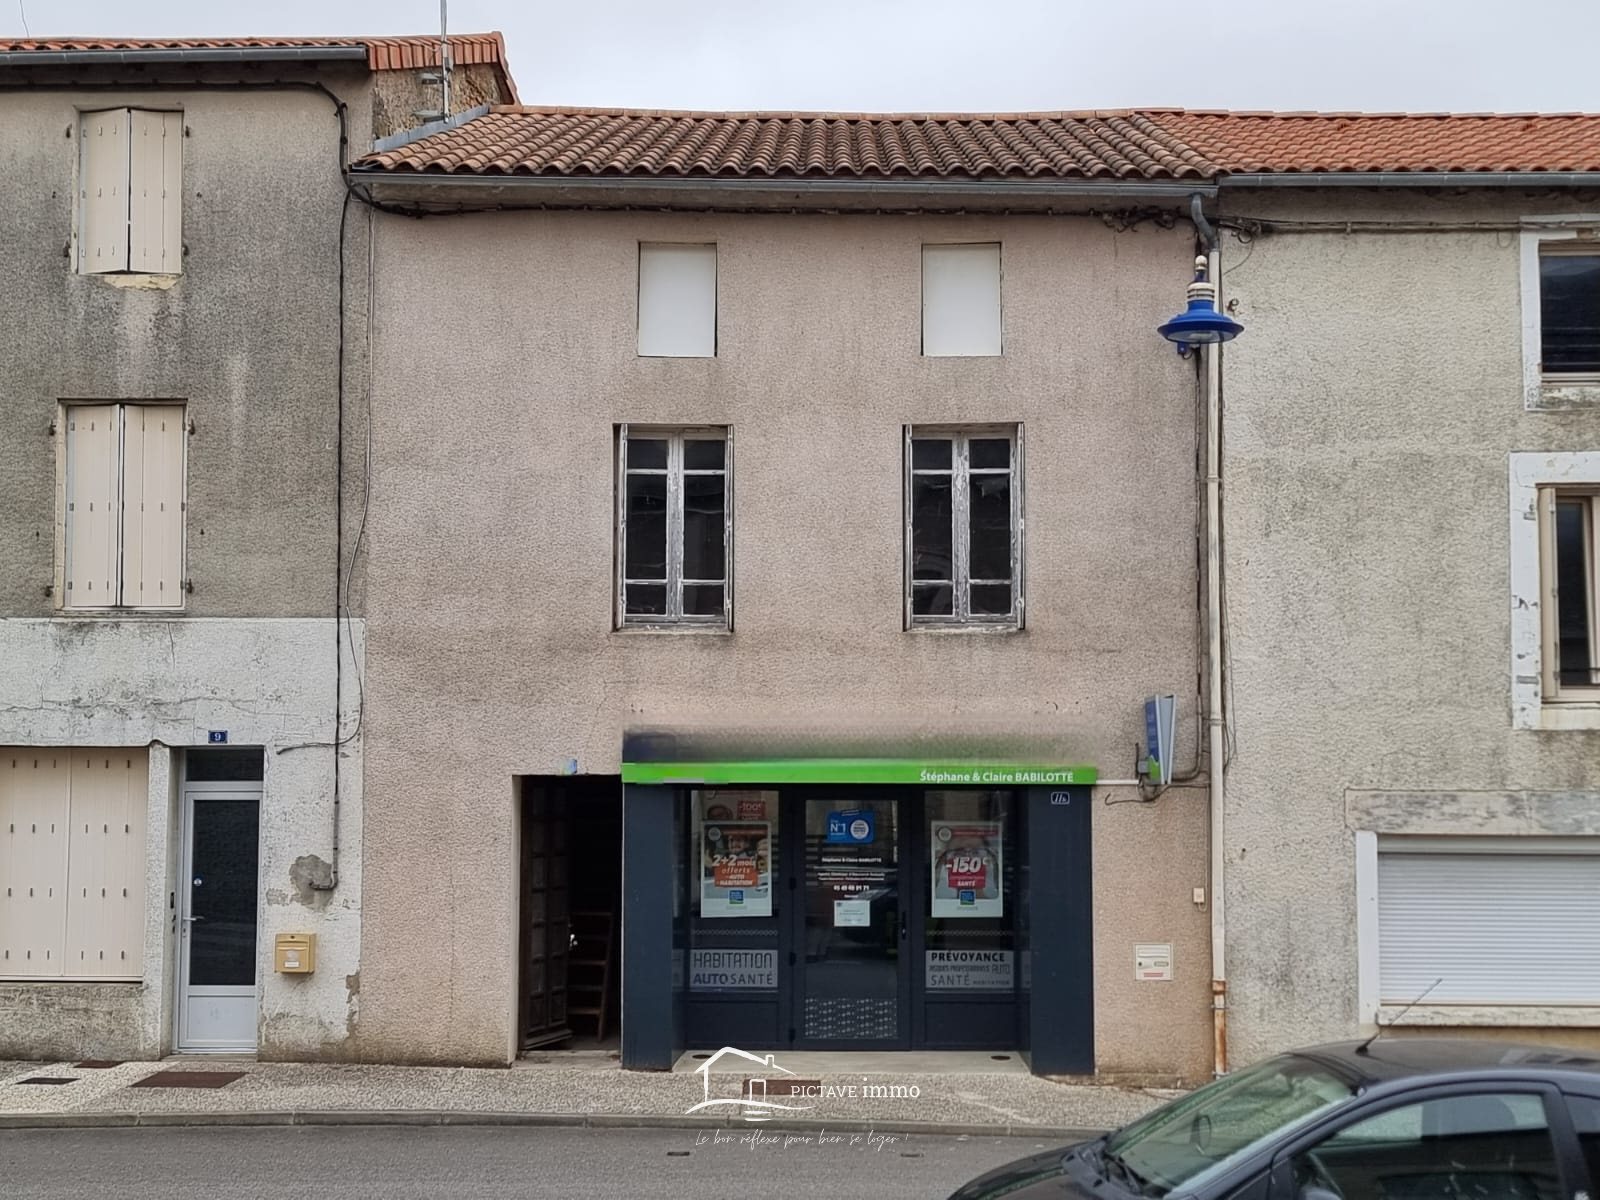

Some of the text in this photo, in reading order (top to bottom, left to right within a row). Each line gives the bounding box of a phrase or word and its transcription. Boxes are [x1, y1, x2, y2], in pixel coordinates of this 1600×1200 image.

[214, 732, 221, 741] 9
[919, 769, 1074, 784] Stéphane & Claire BABILOTTE
[711, 854, 737, 867] 2+2
[721, 866, 751, 874] offerts
[693, 952, 773, 969] HABITATION
[930, 949, 1005, 962] PRÉVOYANCE
[693, 970, 773, 985] AUTO SANTÉ
[930, 972, 970, 986] SANTÉ
